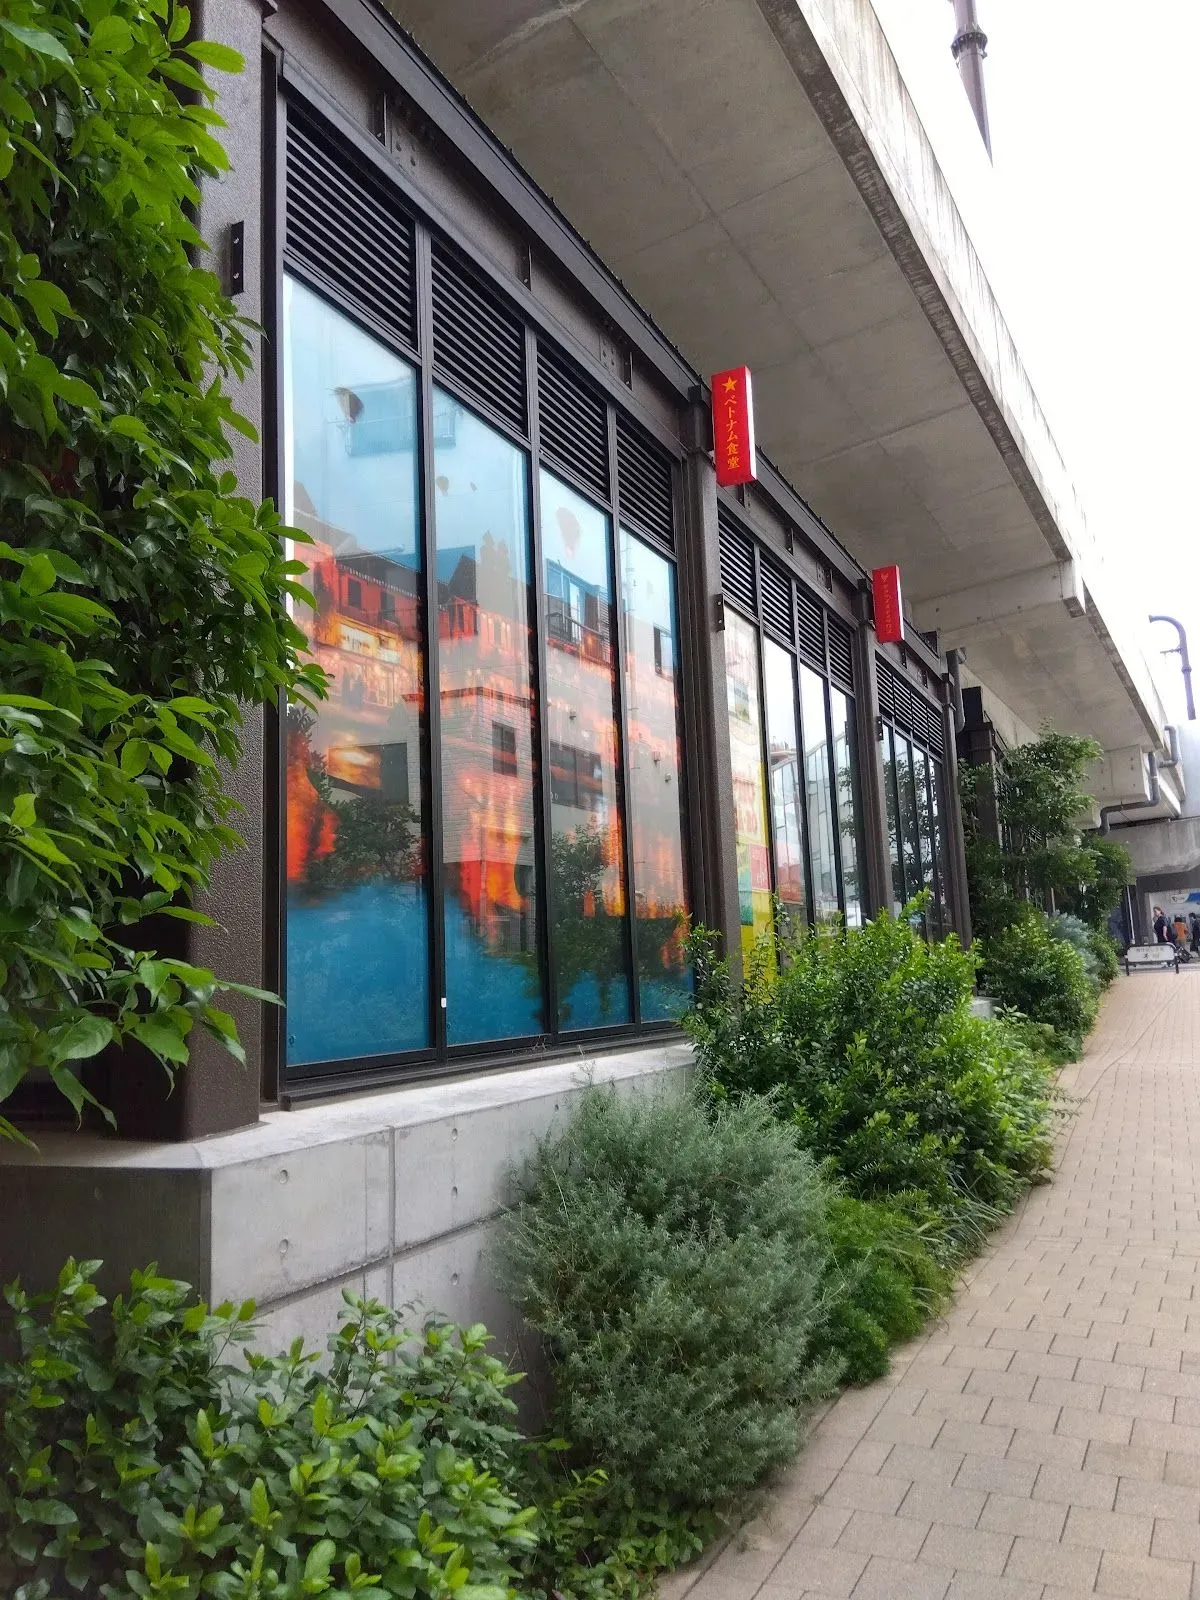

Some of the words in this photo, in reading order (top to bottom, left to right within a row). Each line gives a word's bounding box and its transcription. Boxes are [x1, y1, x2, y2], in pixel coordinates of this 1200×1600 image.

[724, 395, 740, 470] ベトナム食堂
